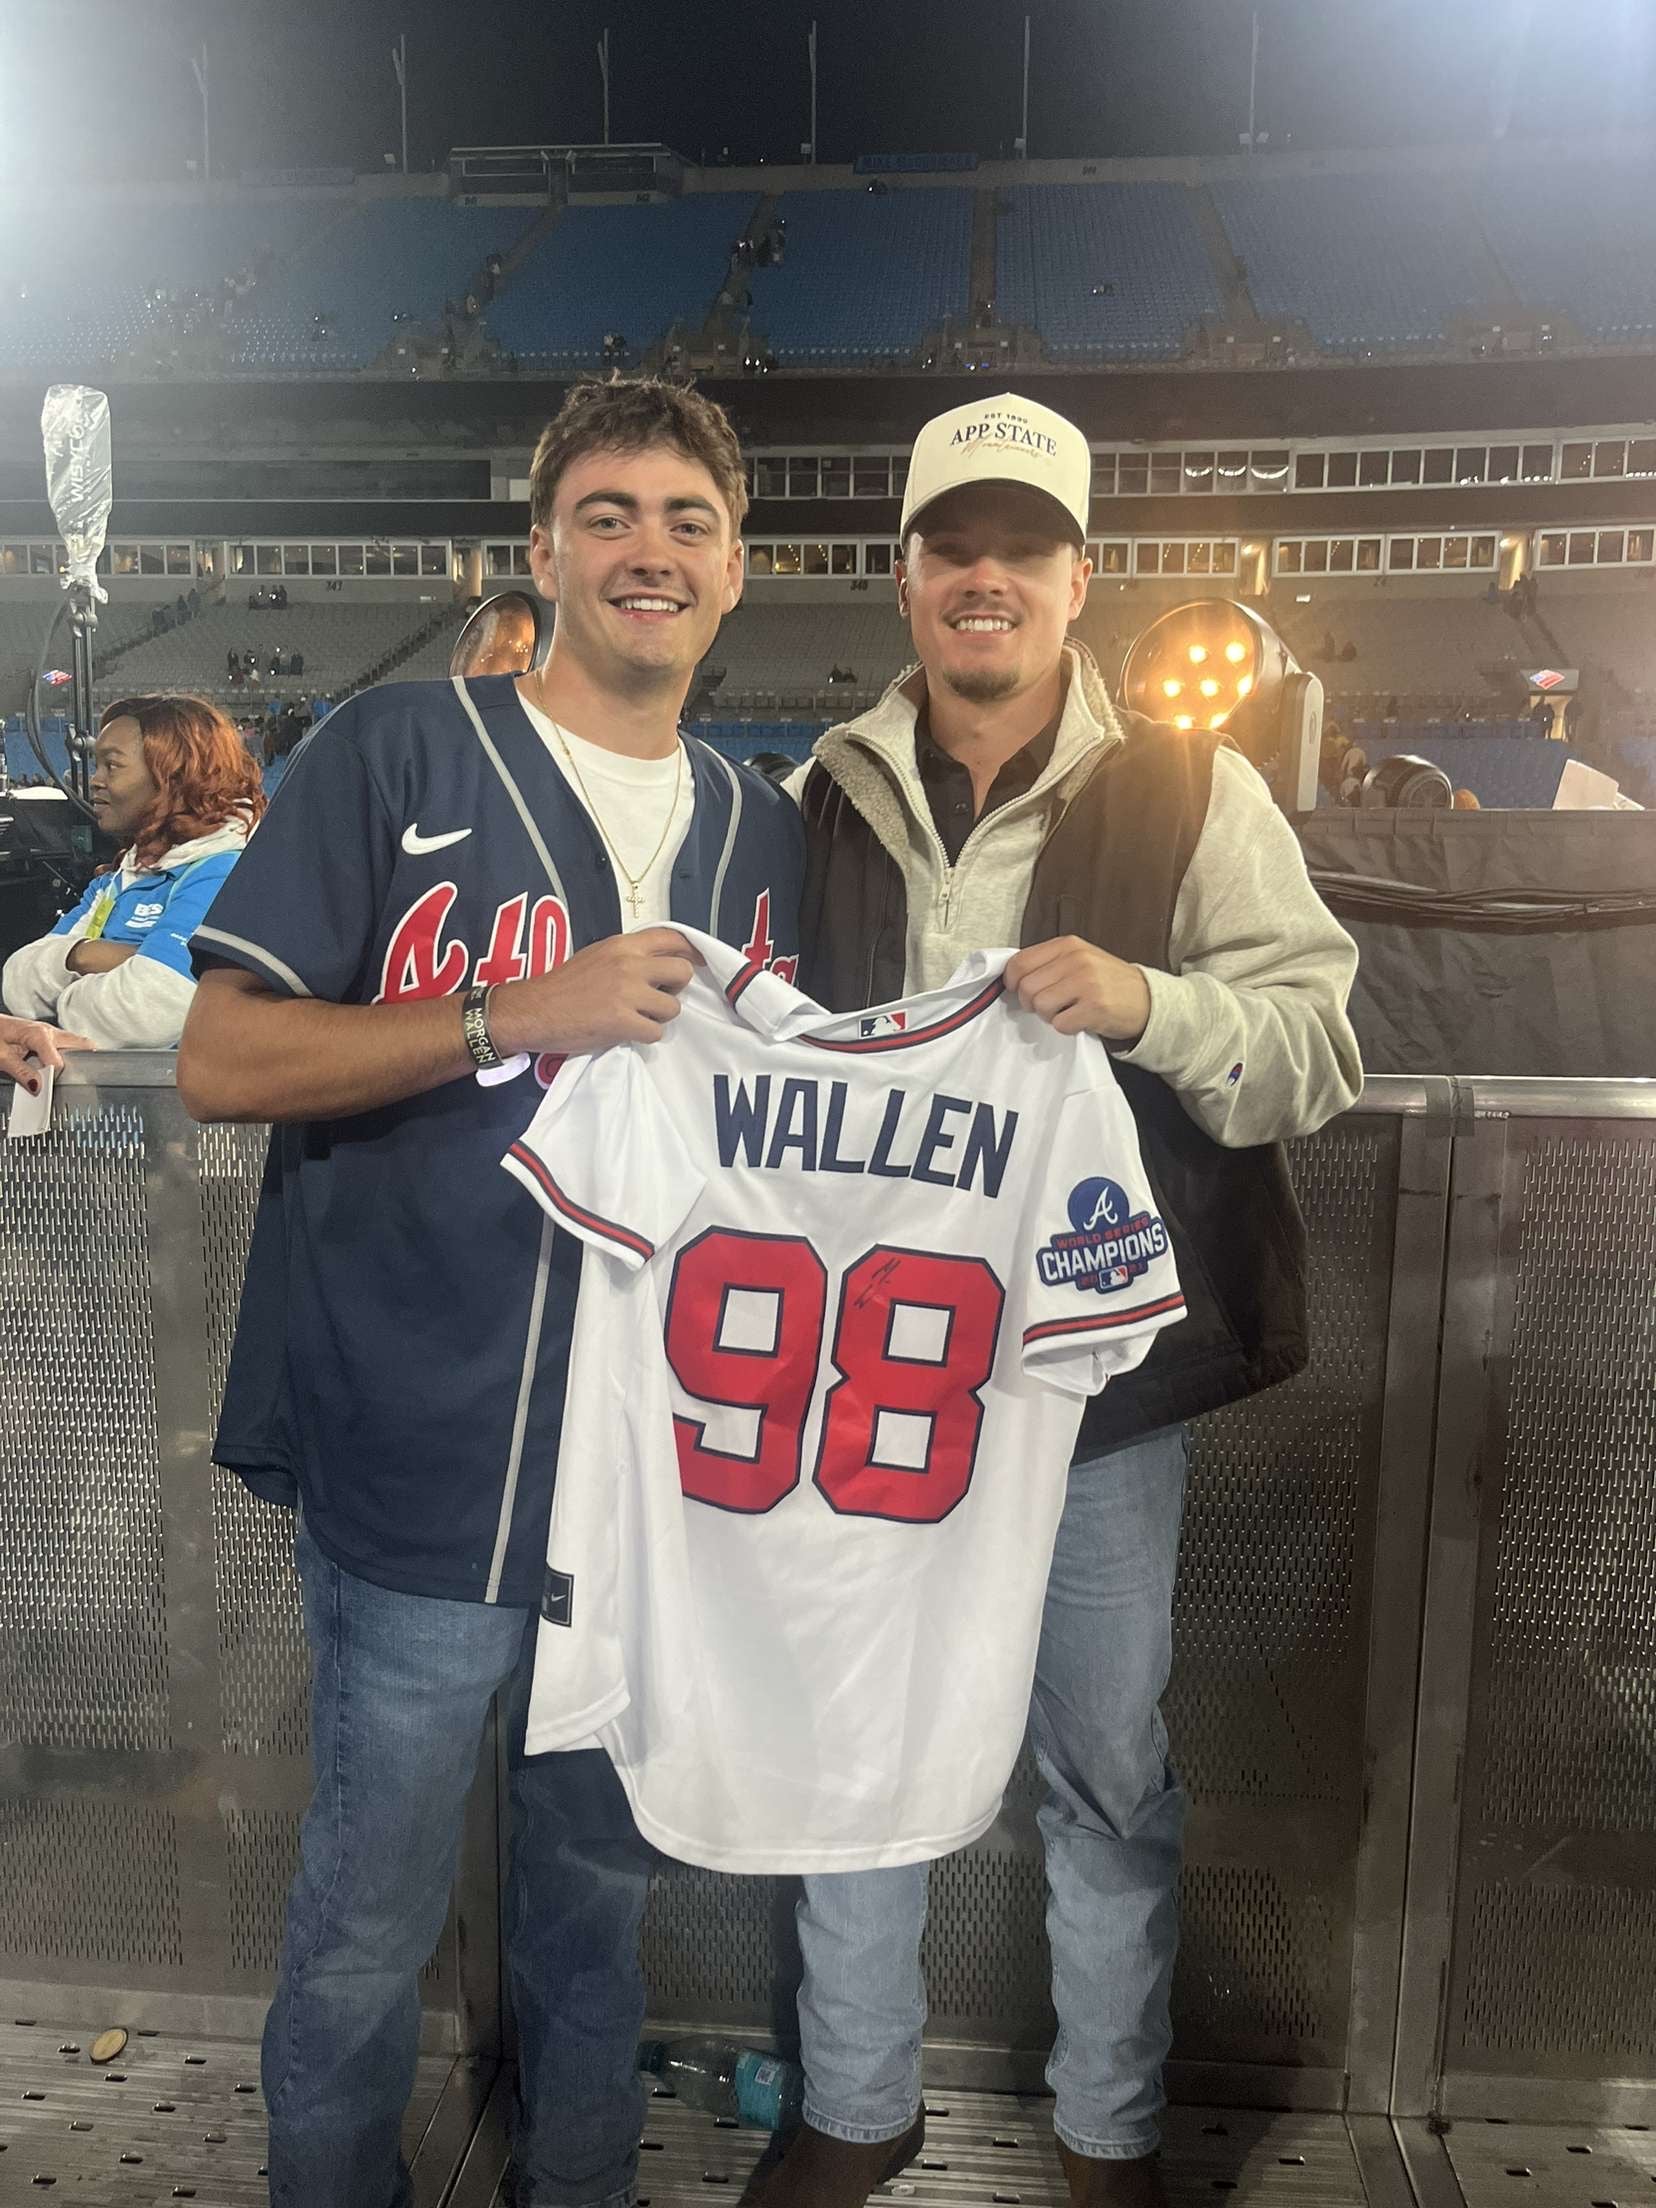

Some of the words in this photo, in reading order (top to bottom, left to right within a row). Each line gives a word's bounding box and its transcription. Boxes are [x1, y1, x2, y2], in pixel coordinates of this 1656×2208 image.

[950, 423, 990, 446] APP
[994, 422, 1057, 456] STATE
[465, 1008, 487, 1064] WALLEN
[474, 1007, 496, 1062] MORGAN
[713, 1073, 1019, 1199] WALLEN
[1042, 1222, 1165, 1281] CHAMPIONS
[1056, 1233, 1102, 1249] WORLD
[1104, 1216, 1149, 1240] SERIES
[664, 1224, 1006, 1524] 98
